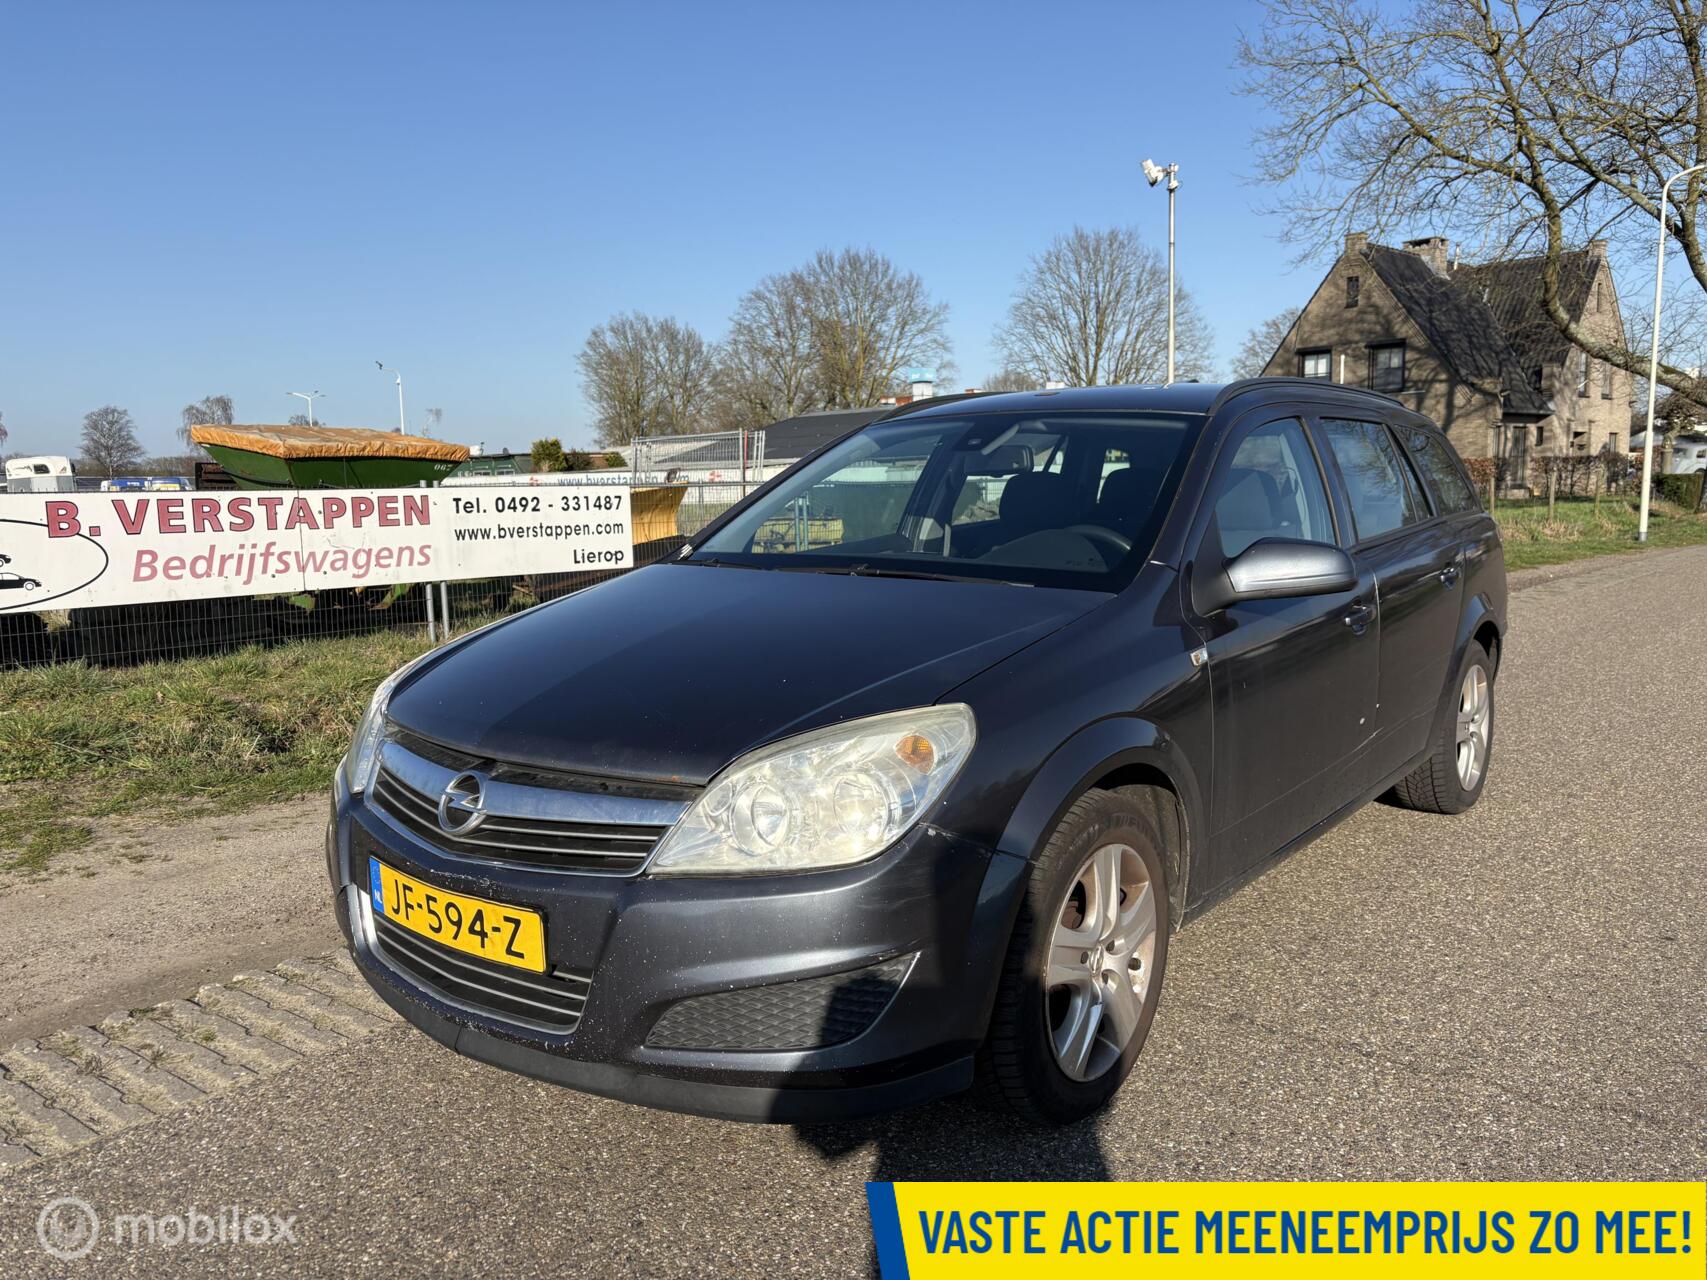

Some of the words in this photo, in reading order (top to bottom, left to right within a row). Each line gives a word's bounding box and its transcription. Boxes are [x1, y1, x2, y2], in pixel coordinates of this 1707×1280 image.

[45, 501, 102, 538] B.
[111, 495, 431, 535] VERSTAPPEN
[453, 497, 487, 514] Tel.
[495, 497, 541, 513] 0492
[561, 495, 623, 511] 331487
[454, 522, 624, 541] www.bverstappen.com
[132, 541, 432, 585] Bedrijfswagens
[573, 549, 625, 565] Lierop
[391, 878, 525, 959] JF-594-Z
